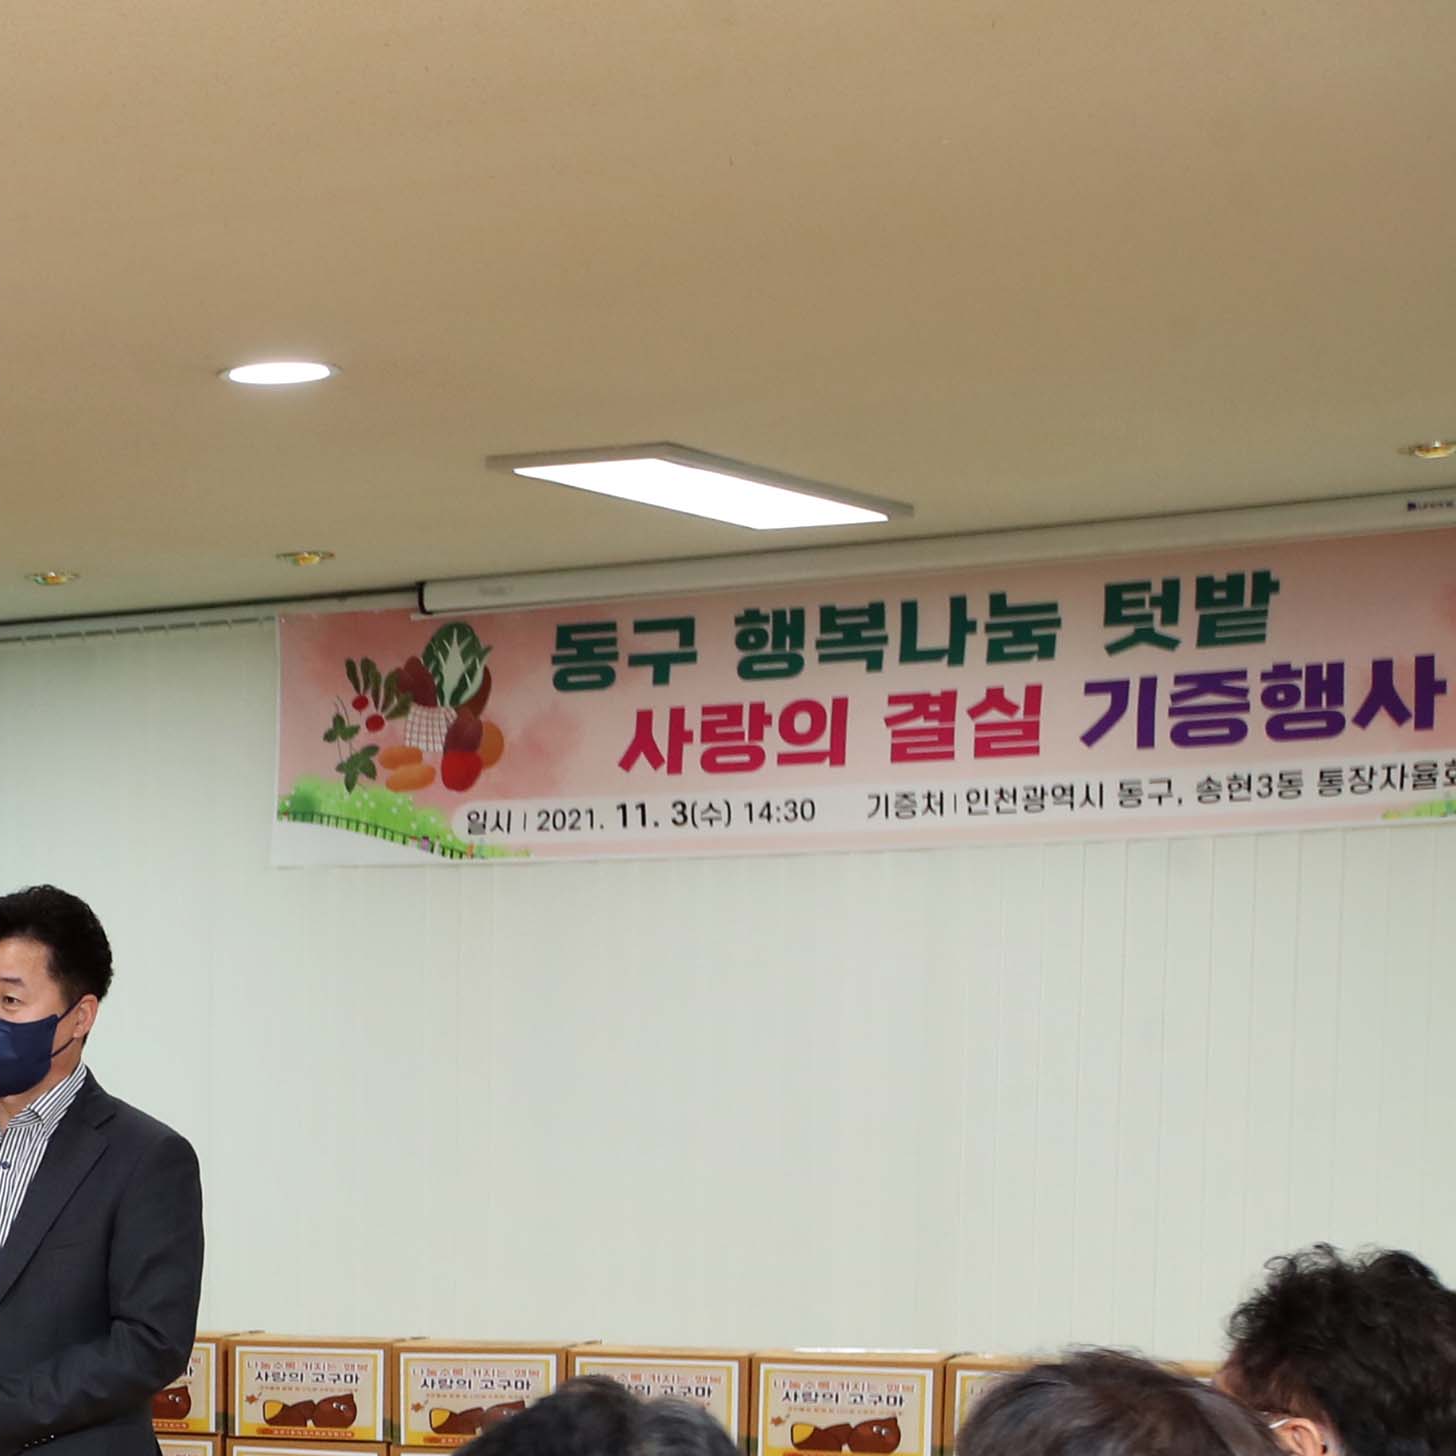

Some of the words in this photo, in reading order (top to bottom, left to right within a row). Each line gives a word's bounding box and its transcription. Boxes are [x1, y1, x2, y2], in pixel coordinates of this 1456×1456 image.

[551, 616, 698, 692] 동구
[734, 592, 1062, 681] 행복나눔
[1103, 570, 1281, 657] 텃밭
[618, 697, 850, 776] 사랑의
[884, 684, 1044, 764] 결실
[1080, 654, 1448, 750] 기증행사
[965, 780, 1105, 816] 인천광역시
[1195, 767, 1305, 804] 송현3동
[466, 808, 512, 836] 일시
[537, 806, 605, 833] 2021.
[616, 801, 660, 829] 11.
[670, 798, 733, 829] 3(수)
[744, 797, 817, 825] 14:30
[255, 1371, 304, 1384] 사랑의
[311, 1373, 361, 1385] 고구마
[420, 1378, 472, 1390] 사랑의
[480, 1378, 532, 1391] 고구마
[782, 1391, 839, 1404] 사랑의
[848, 1393, 905, 1407] 고구마
